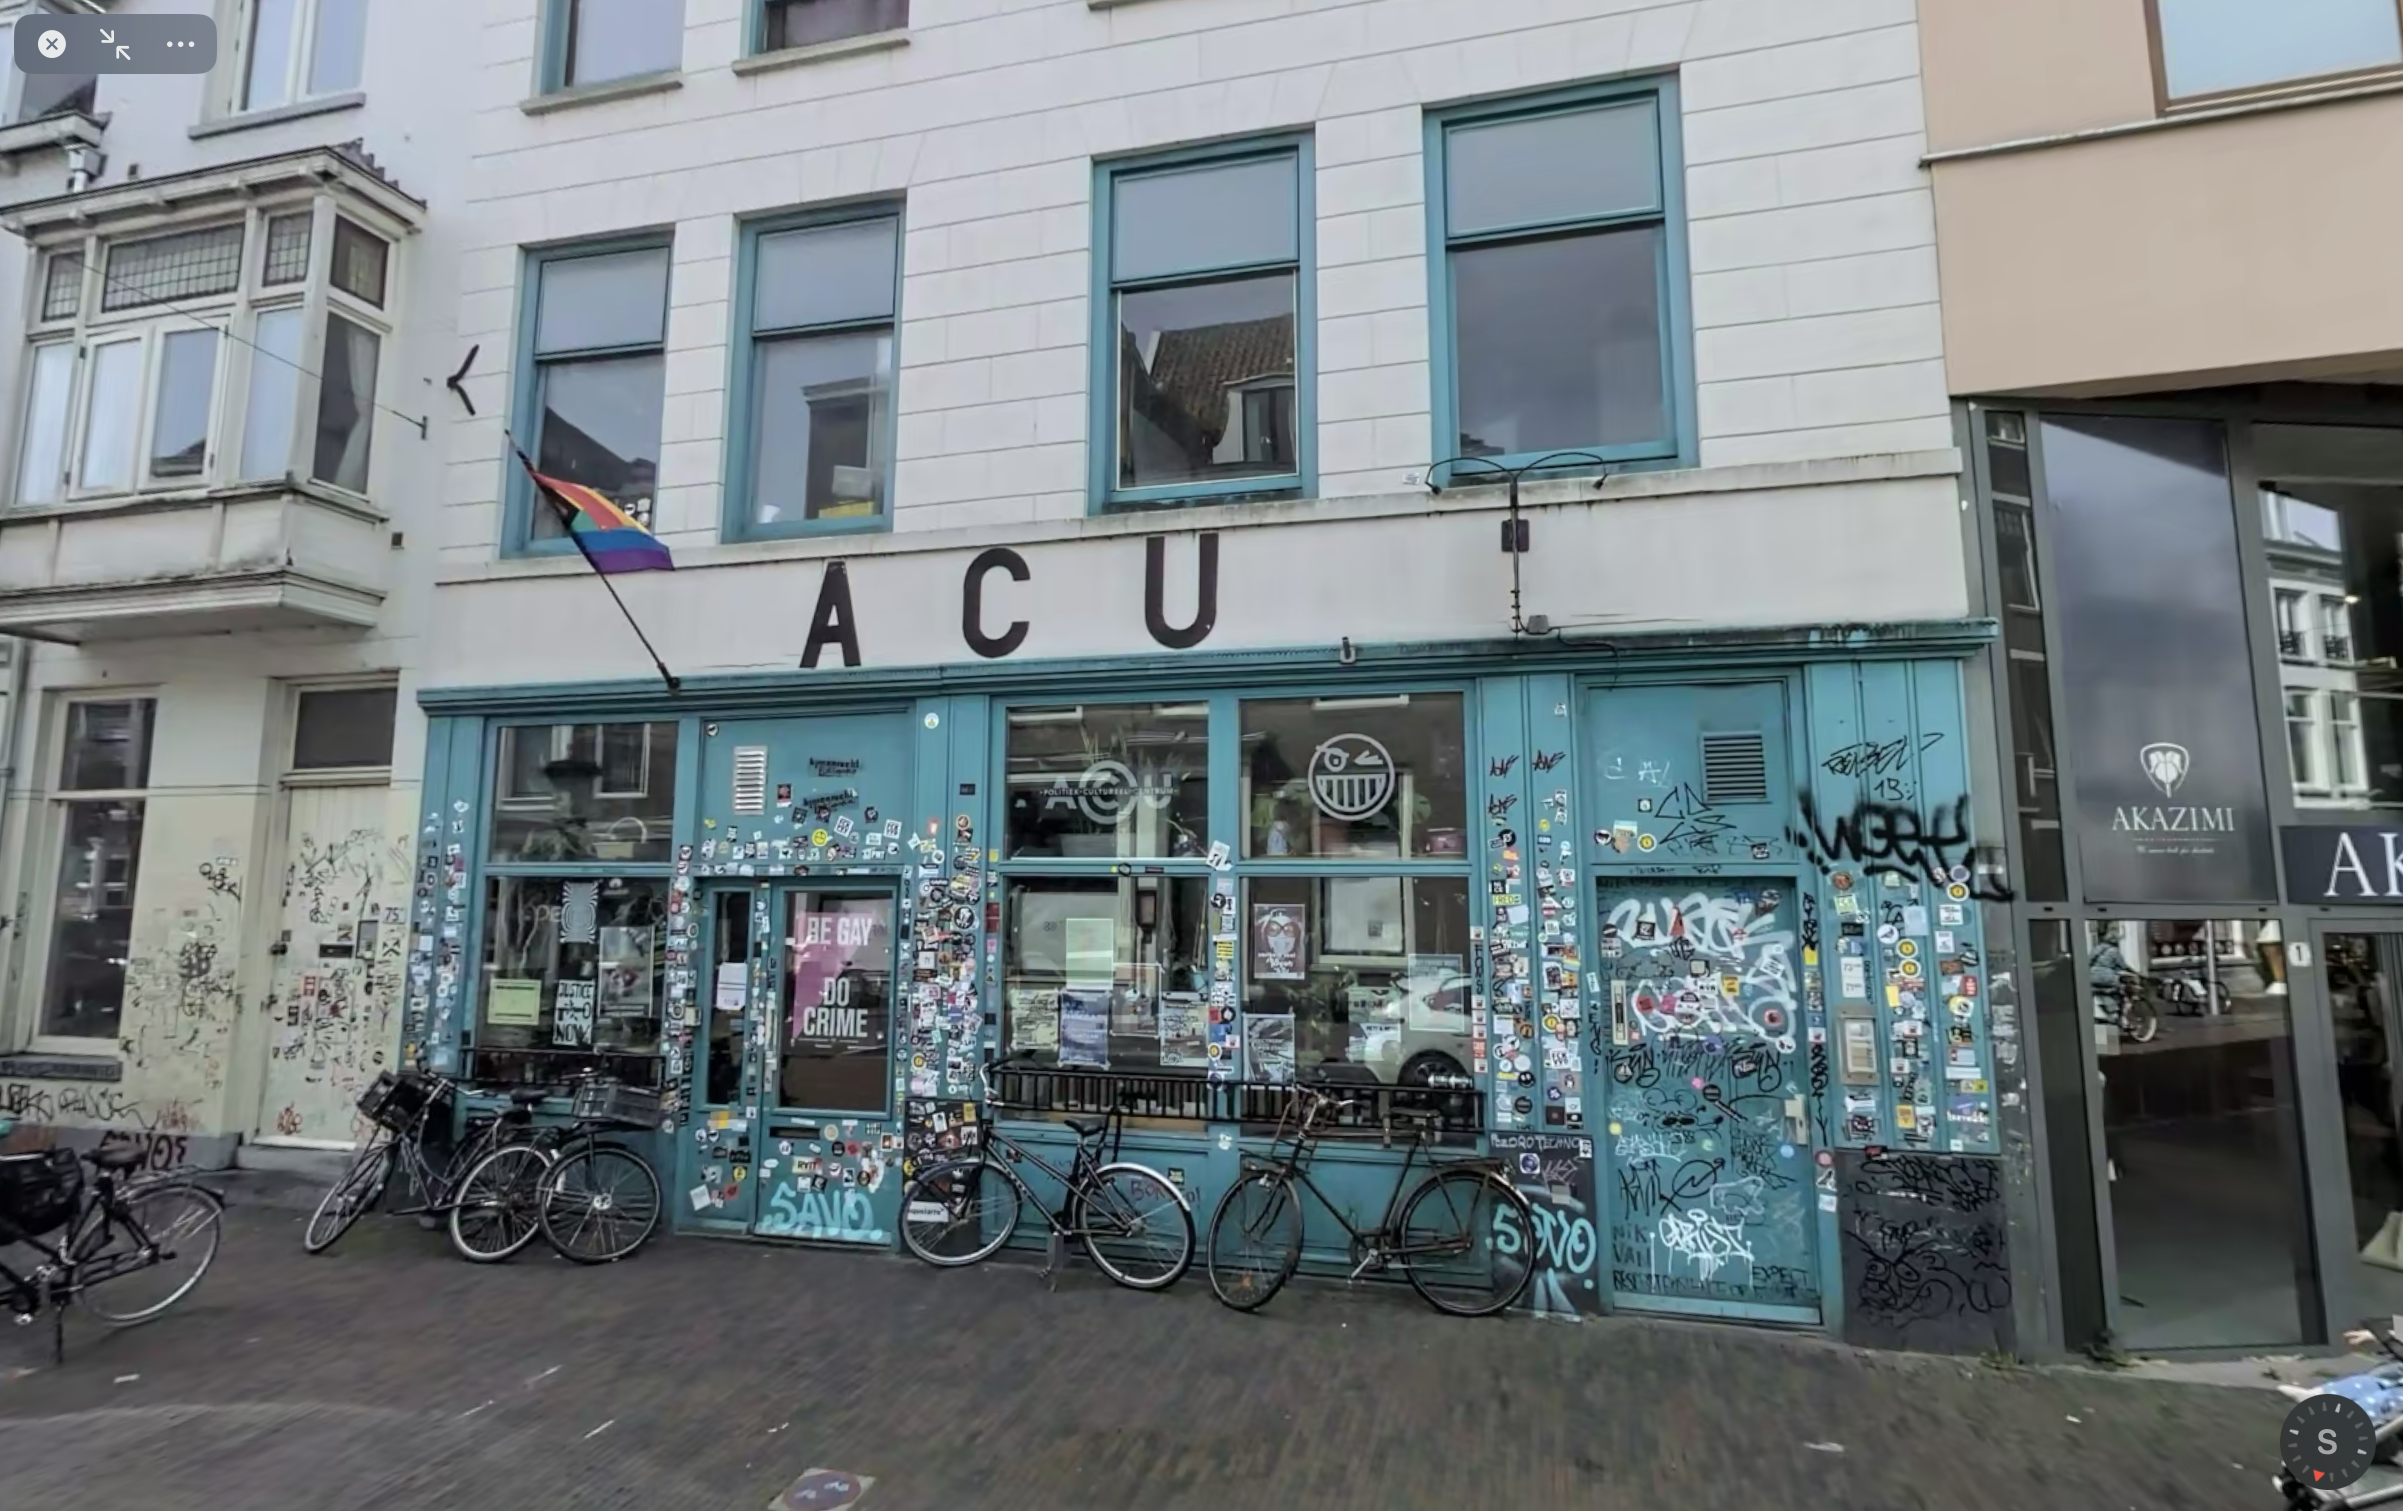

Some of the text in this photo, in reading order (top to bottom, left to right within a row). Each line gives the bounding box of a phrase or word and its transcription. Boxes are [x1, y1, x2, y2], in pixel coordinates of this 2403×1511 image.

[2112, 806, 2235, 832] AKAZIMI
[807, 917, 872, 945] BE GAY
[823, 976, 850, 1006] DO
[803, 1006, 868, 1037] CRIME
